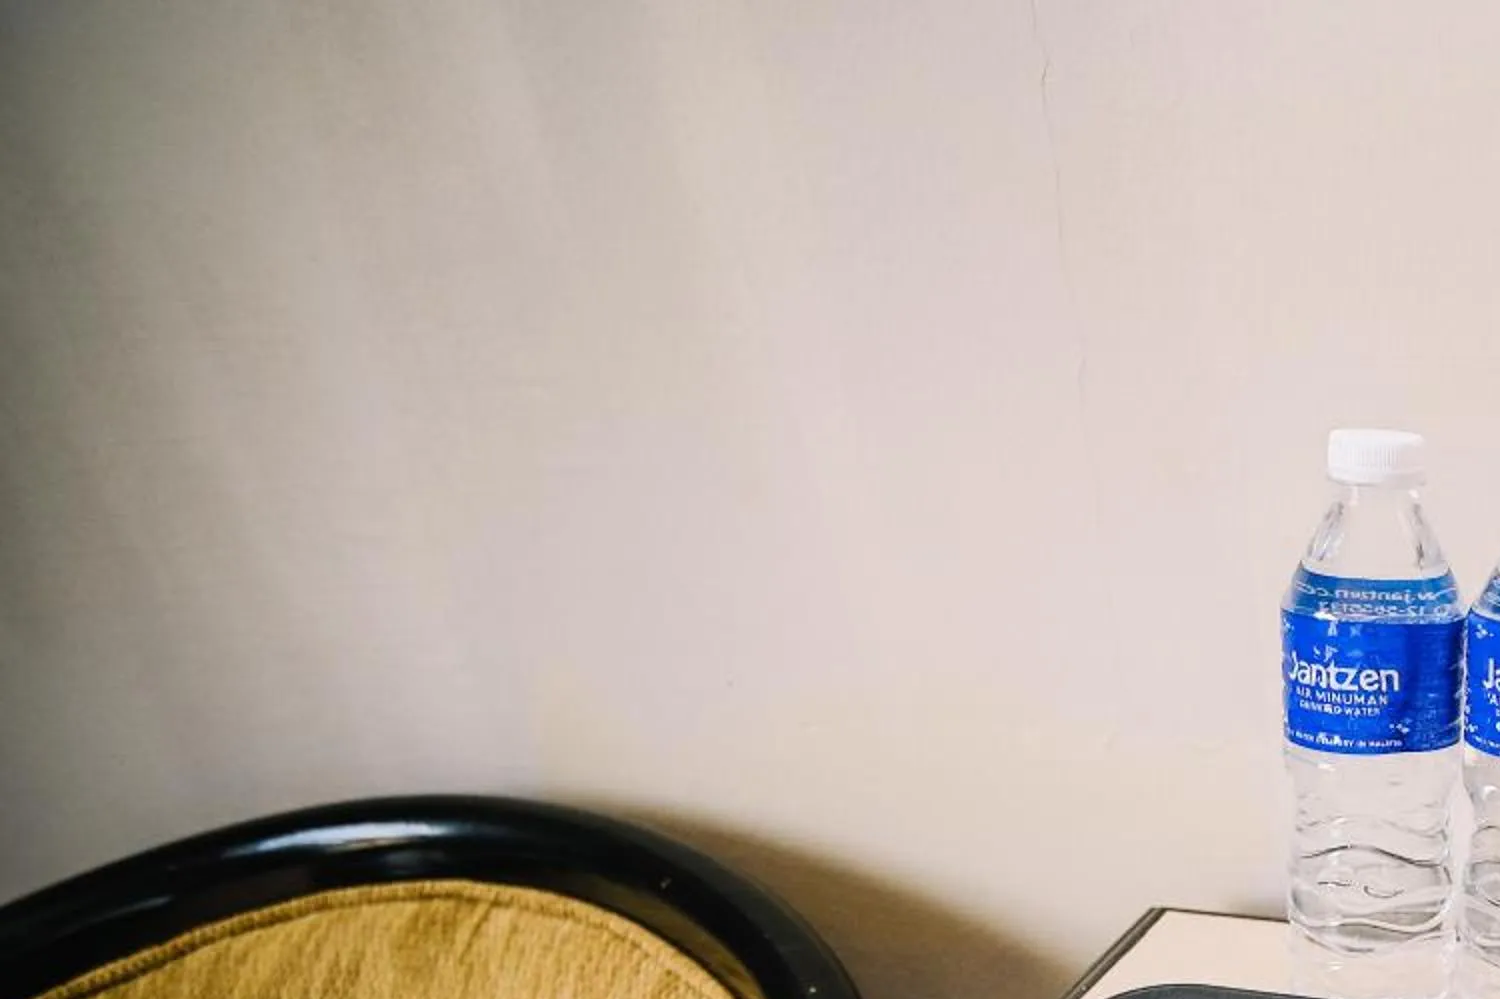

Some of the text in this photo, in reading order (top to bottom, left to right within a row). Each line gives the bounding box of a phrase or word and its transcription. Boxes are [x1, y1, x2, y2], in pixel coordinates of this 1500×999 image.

[1287, 651, 1399, 692] Jantzen
[1316, 690, 1388, 704] MINUMAN
[1345, 706, 1380, 717] WATER
